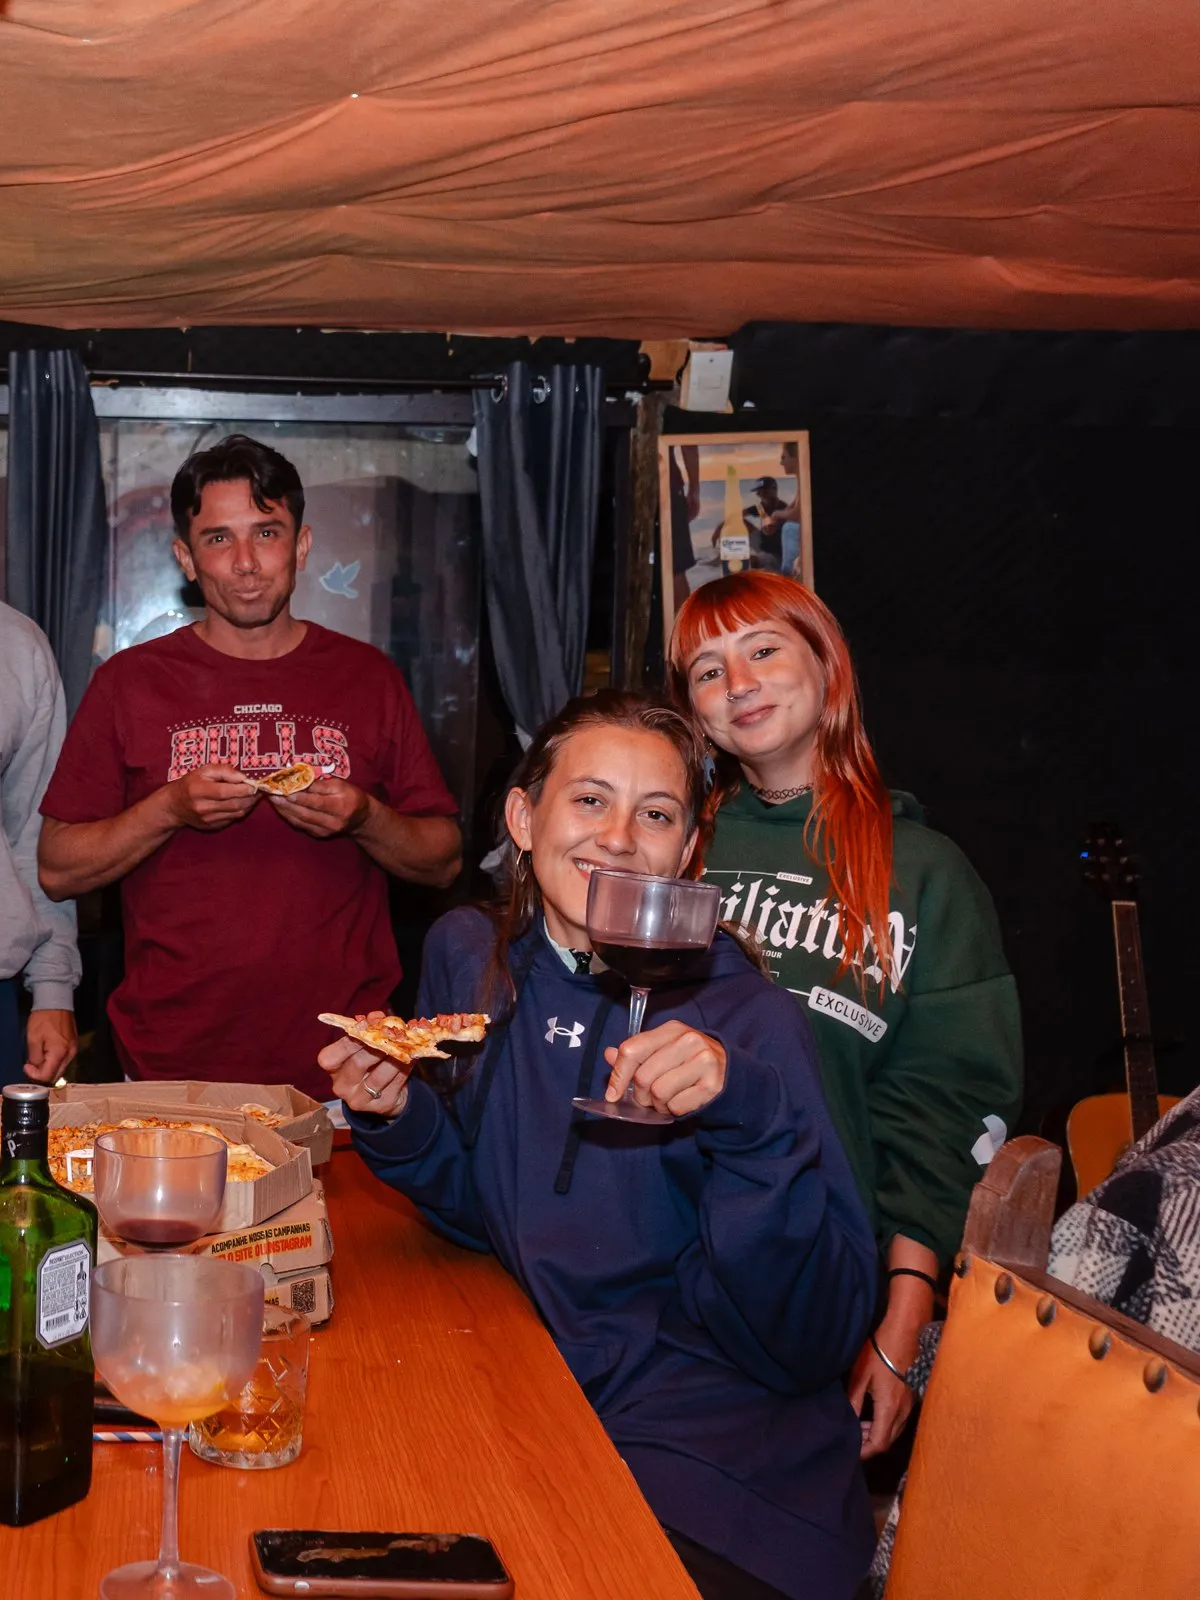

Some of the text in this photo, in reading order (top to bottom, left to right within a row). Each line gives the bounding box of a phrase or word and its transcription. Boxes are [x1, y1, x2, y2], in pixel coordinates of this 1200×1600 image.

[233, 704, 283, 714] CHICAGO
[167, 721, 351, 782] BULLS
[778, 872, 811, 883] EXCLUSIVE
[762, 949, 783, 959] TOUR
[815, 992, 883, 1037] EXCLUSIVE
[211, 1223, 311, 1254] ACOMPANHE NOSSAS CAMPANHAS
[234, 1246, 253, 1262] SITE
[266, 1235, 312, 1254] INSTAGRAM
